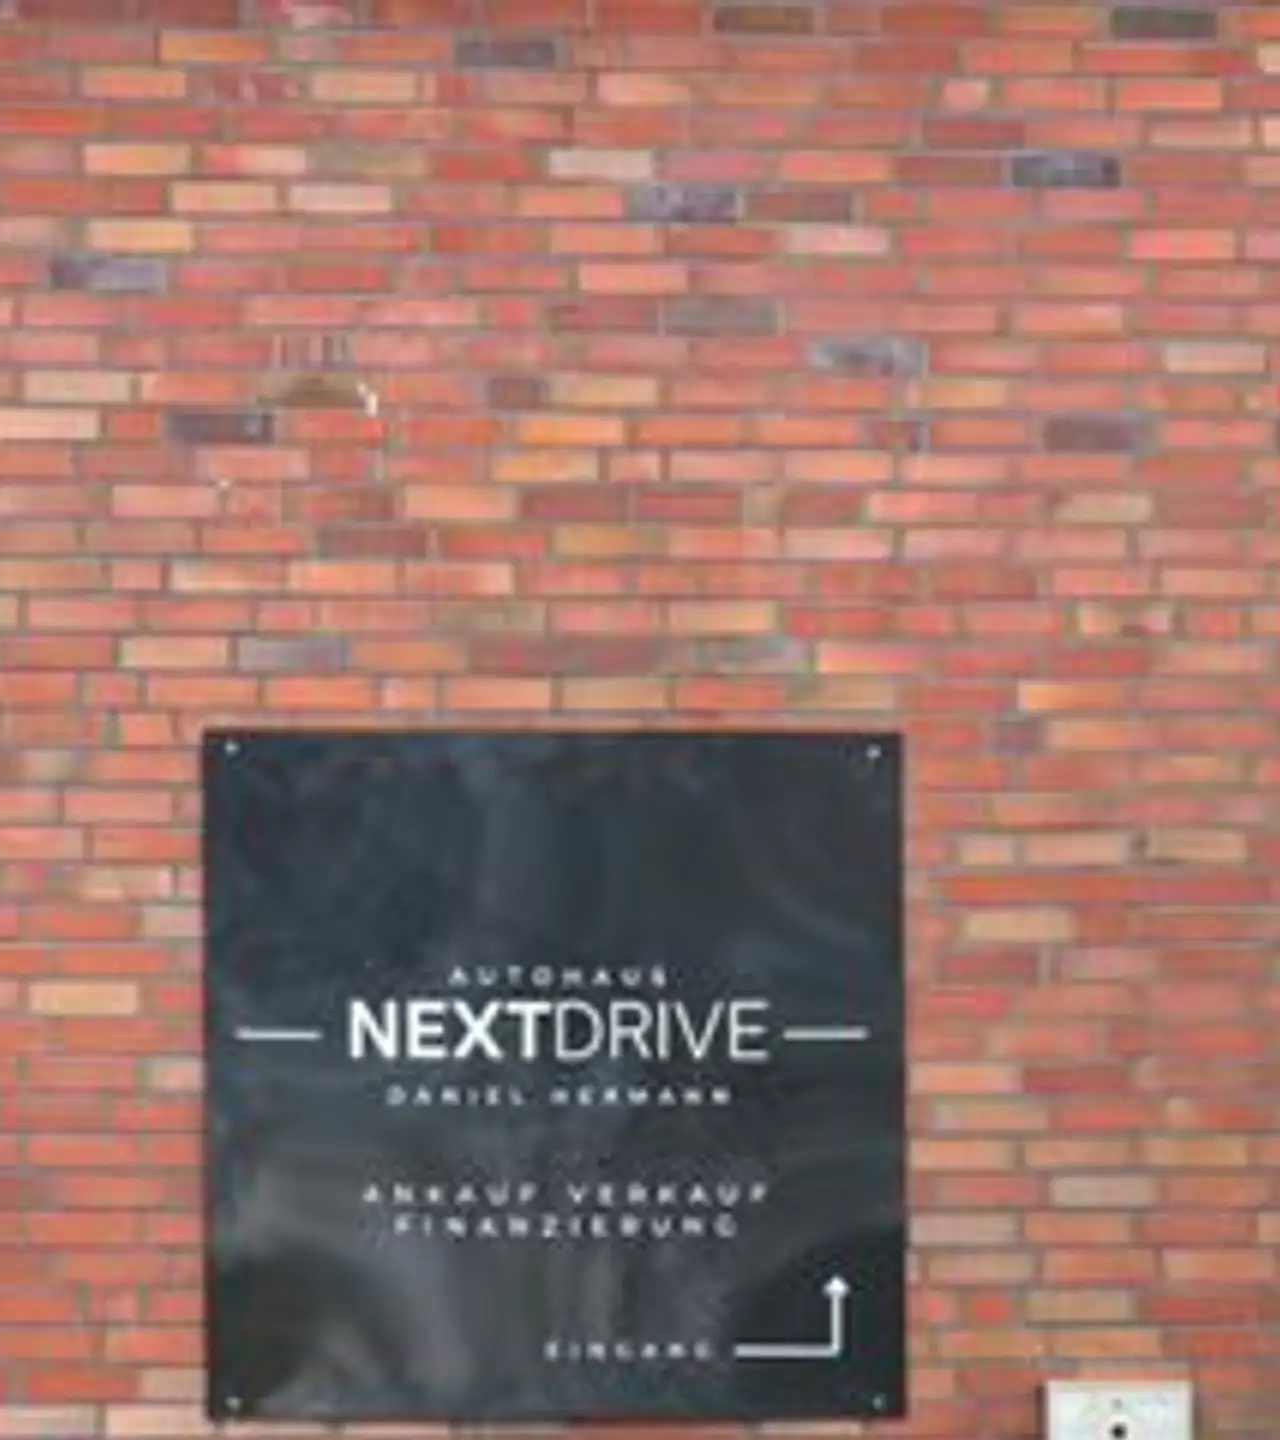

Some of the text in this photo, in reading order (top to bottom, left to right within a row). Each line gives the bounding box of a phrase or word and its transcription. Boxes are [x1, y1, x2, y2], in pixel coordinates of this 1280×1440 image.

[447, 964, 668, 988] AUTOHAUS
[348, 998, 771, 1062] NEXTDRIVE
[385, 1085, 526, 1107] DANIEL
[361, 1181, 768, 1206] ANKAUF VERKAUF
[393, 1213, 737, 1238] FINANZIERUNG
